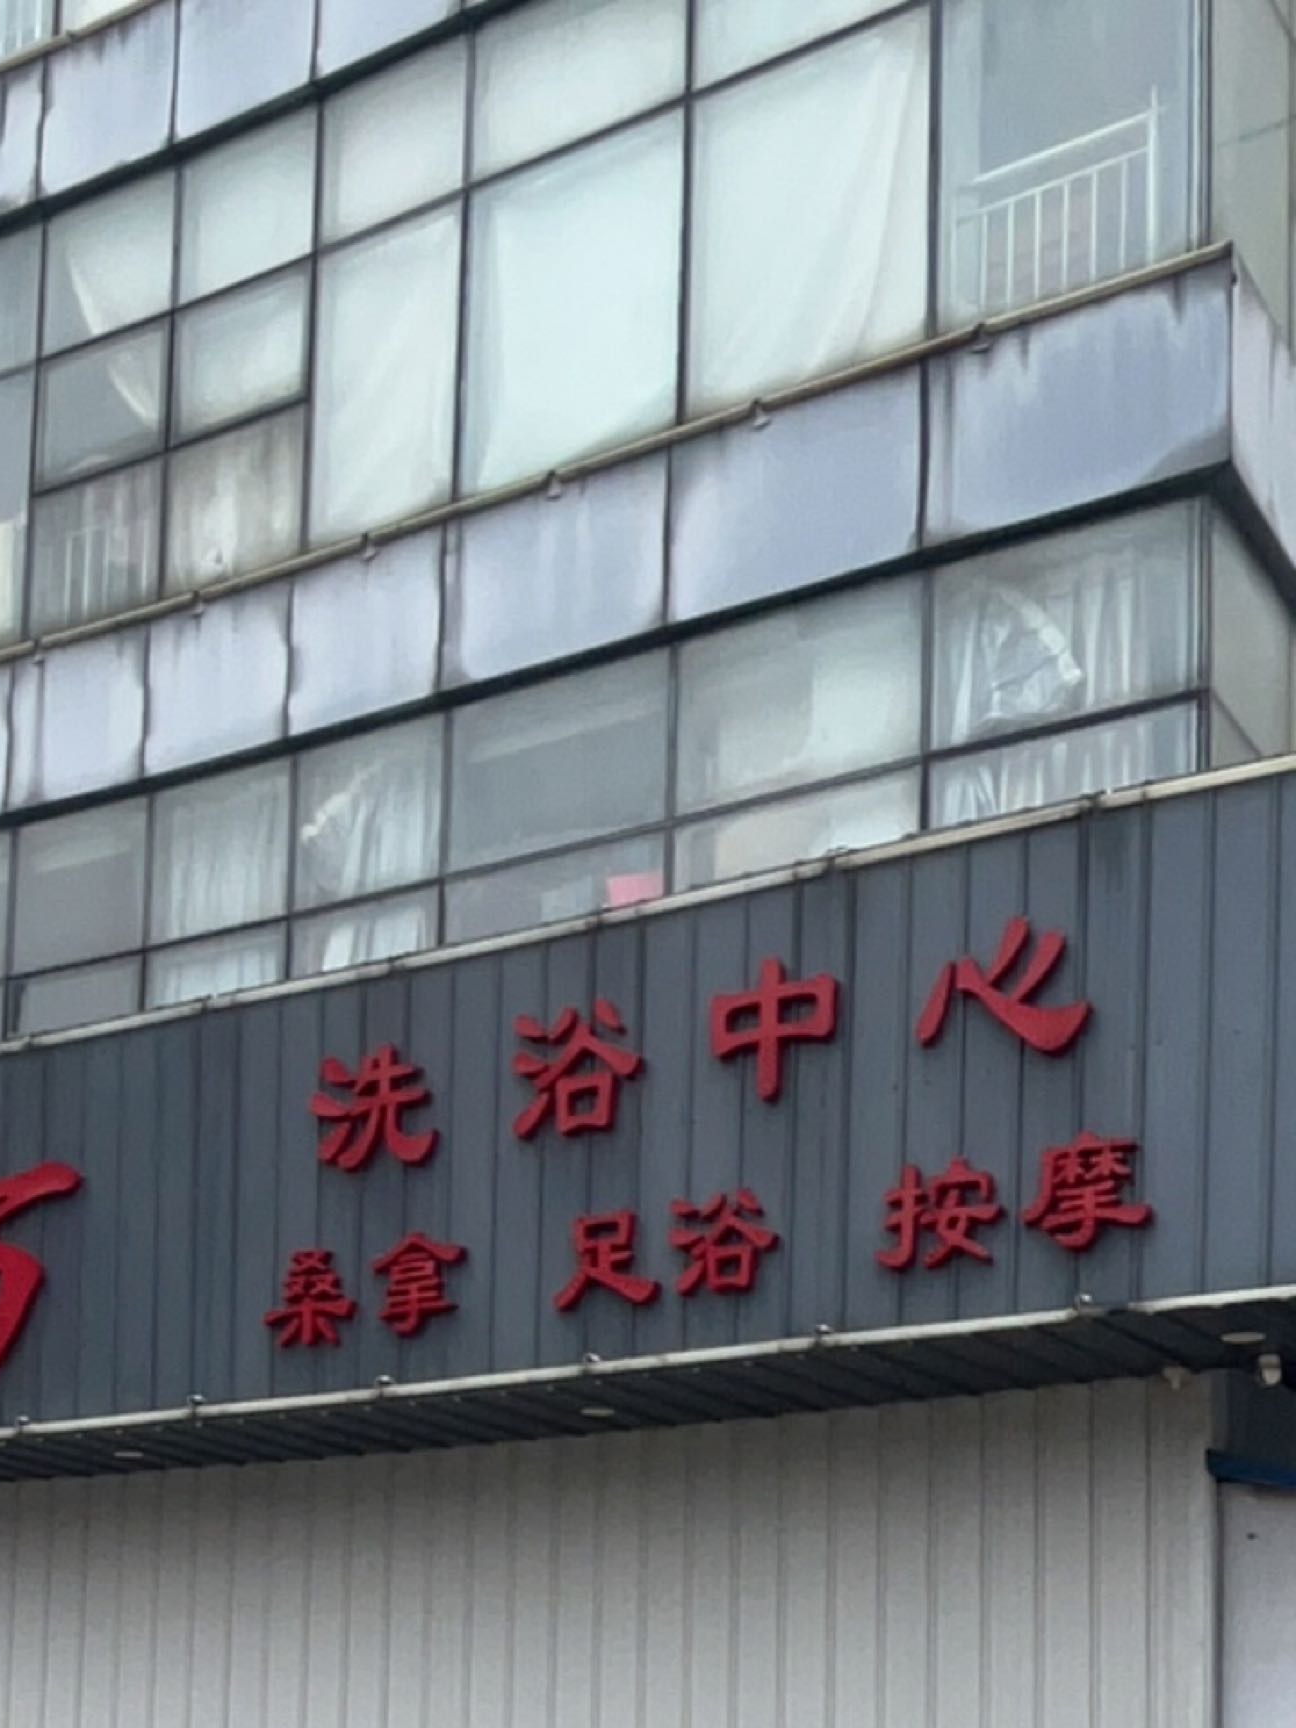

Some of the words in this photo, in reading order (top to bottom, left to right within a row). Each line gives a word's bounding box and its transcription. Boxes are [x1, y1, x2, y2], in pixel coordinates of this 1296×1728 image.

[311, 917, 1092, 1171] 洗浴中心
[264, 1231, 464, 1346] 桑拿
[554, 1189, 778, 1310] 足浴
[876, 1131, 1153, 1269] 按摩
